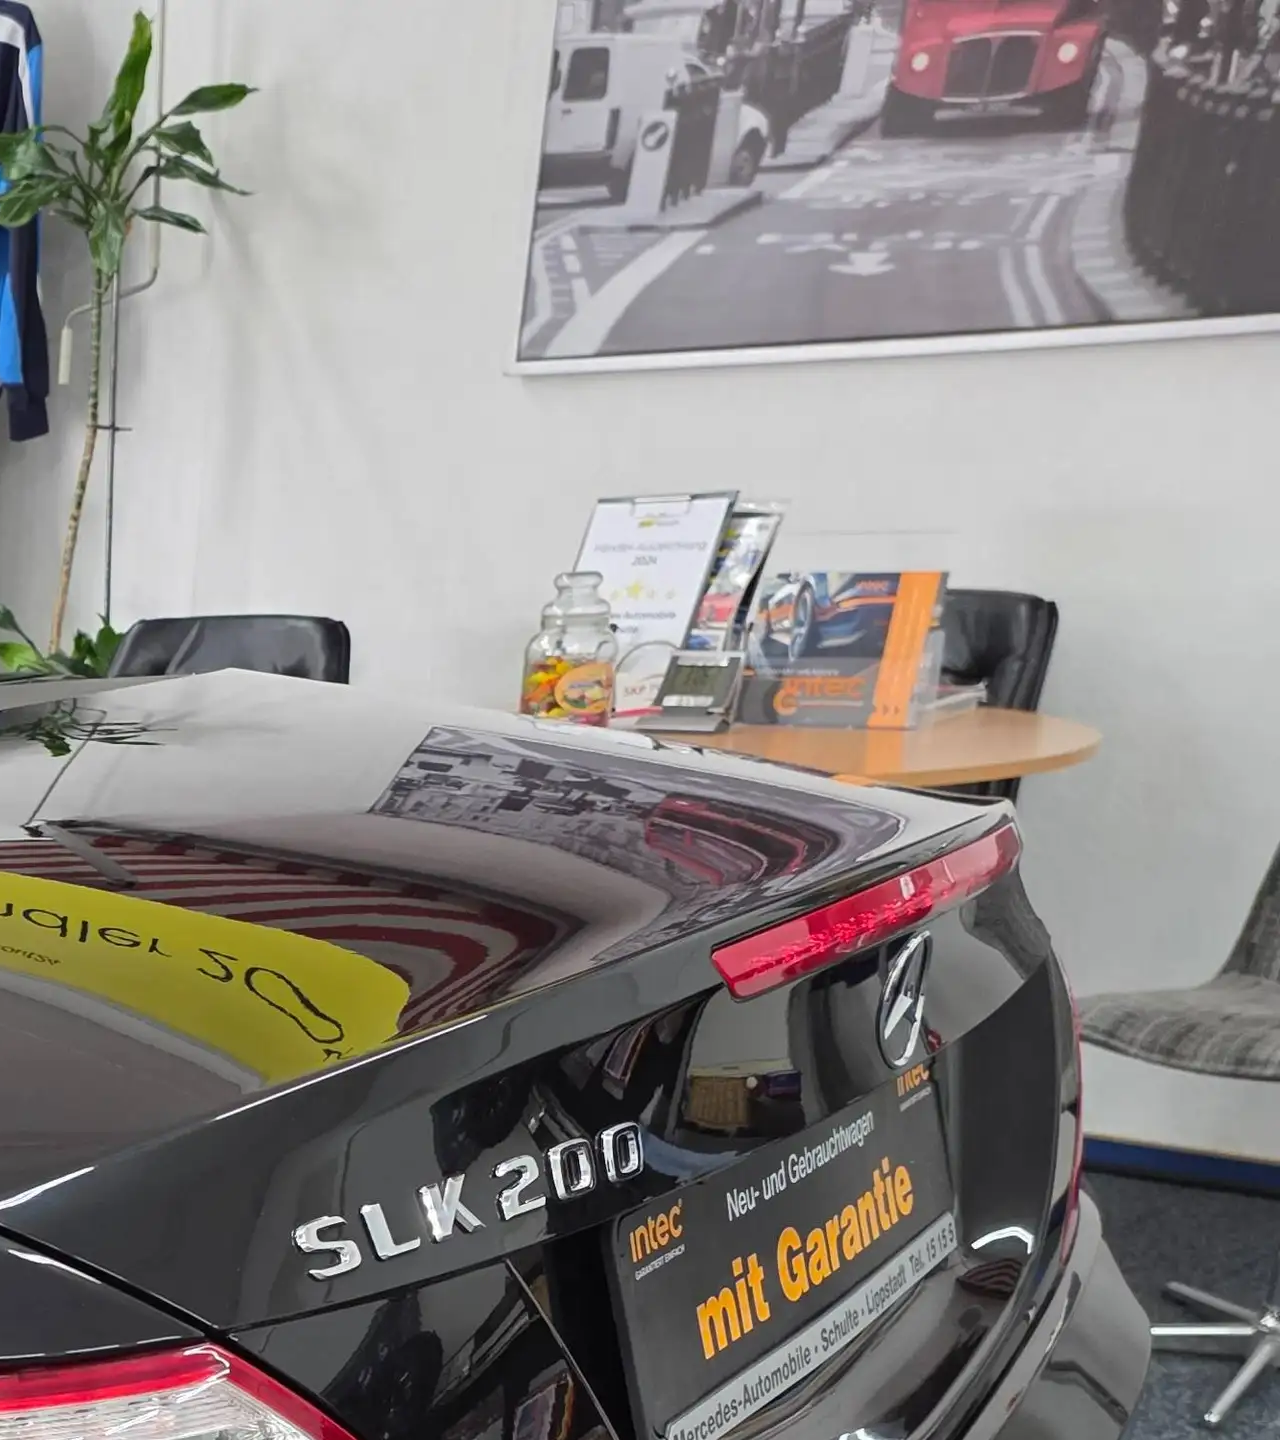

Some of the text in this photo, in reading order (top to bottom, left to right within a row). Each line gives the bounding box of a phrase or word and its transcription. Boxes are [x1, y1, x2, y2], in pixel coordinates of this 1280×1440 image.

[291, 1120, 645, 1282] SLK 200
[726, 1110, 874, 1221] Neu- und Gebrauchtwagen
[696, 1156, 914, 1360] mit Garantie
[820, 1311, 860, 1352] Schulte
[864, 1264, 907, 1314] Lippstadt
[909, 1252, 925, 1278] Tel.
